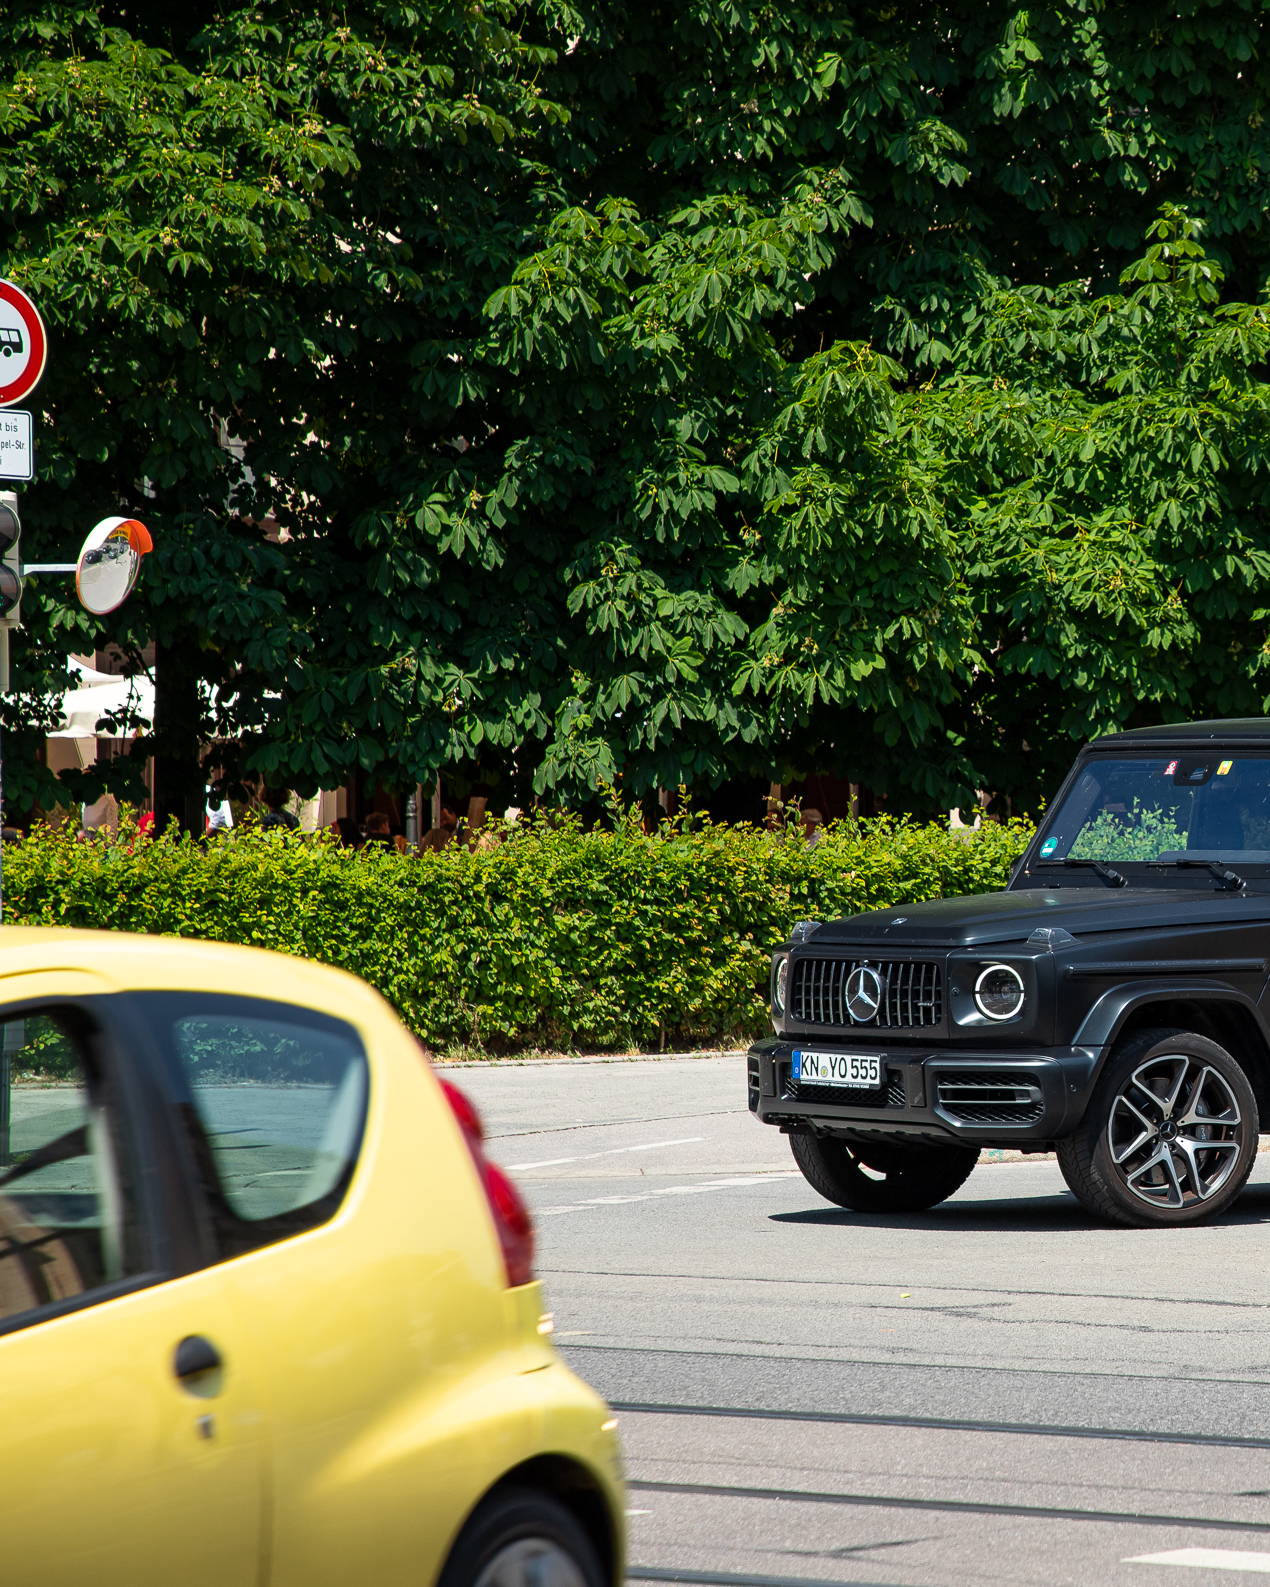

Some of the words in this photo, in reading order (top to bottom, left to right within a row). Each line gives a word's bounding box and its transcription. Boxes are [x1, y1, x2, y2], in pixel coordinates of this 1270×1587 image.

[5, 422, 18, 432] bis
[801, 1055, 819, 1077] KN
[829, 1056, 847, 1079] YO
[851, 1058, 878, 1080] 555
